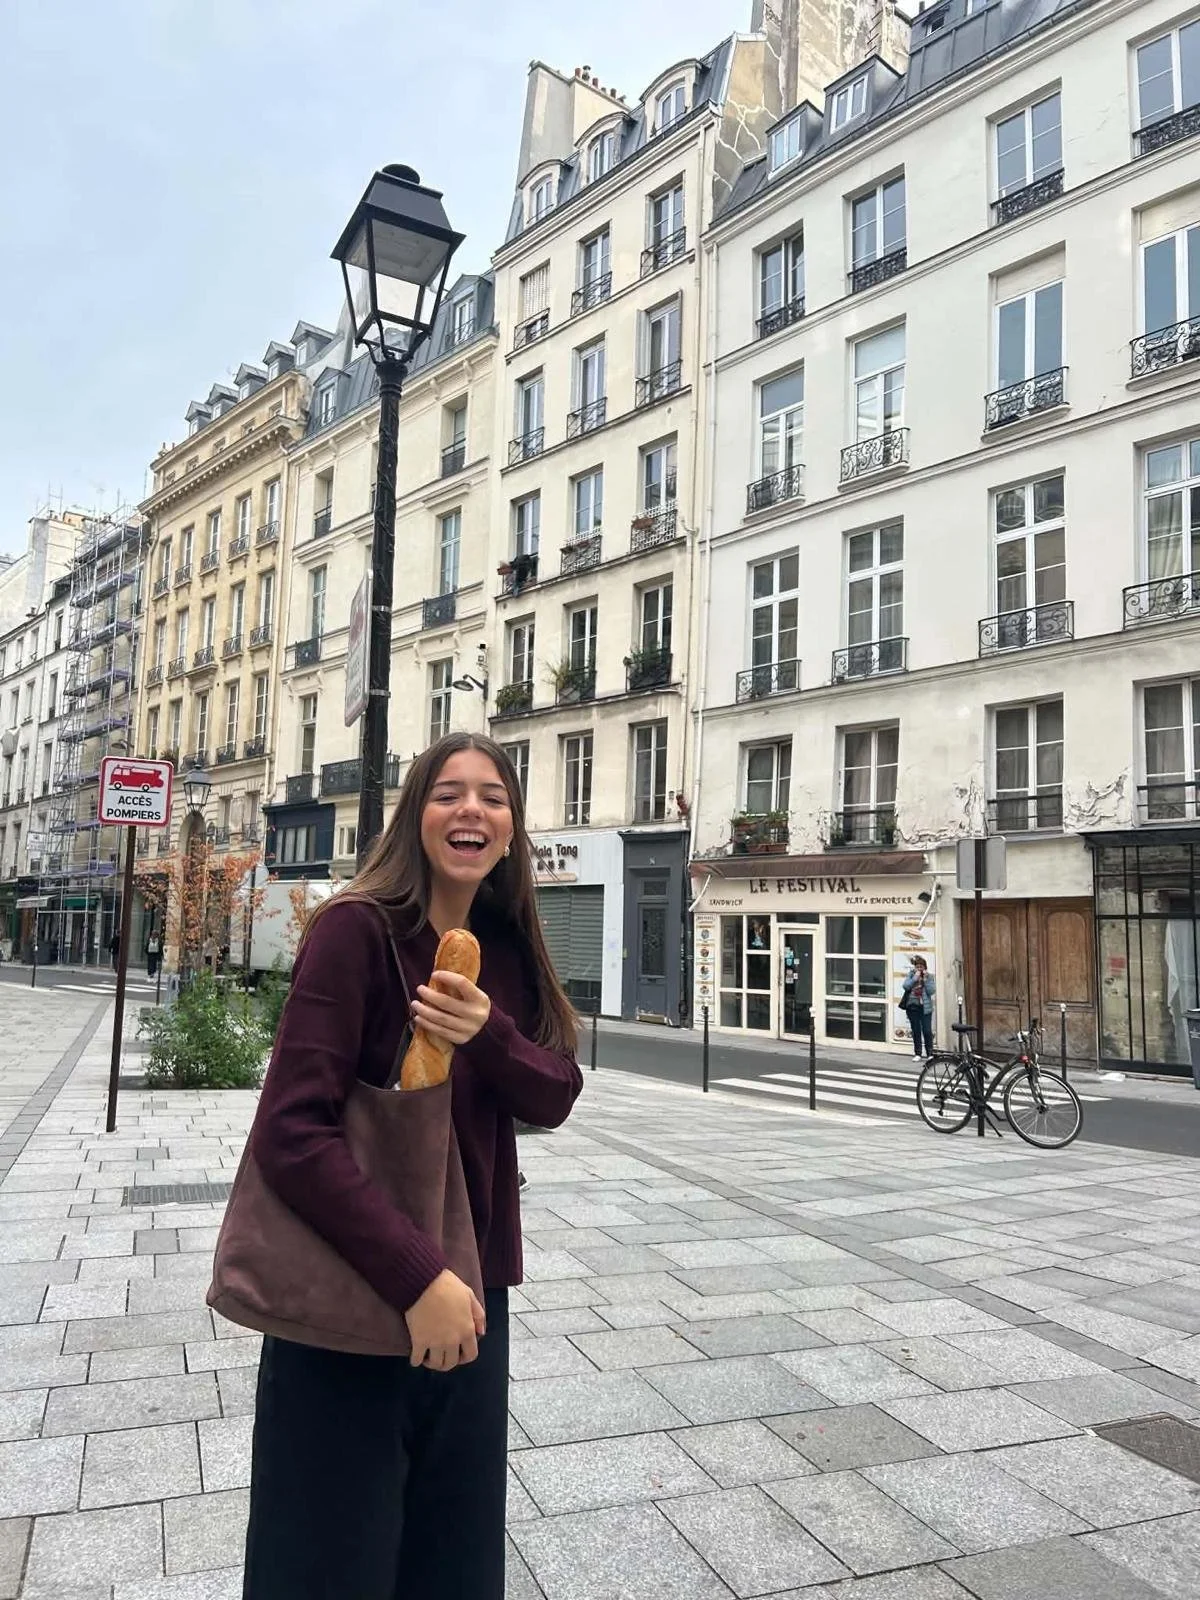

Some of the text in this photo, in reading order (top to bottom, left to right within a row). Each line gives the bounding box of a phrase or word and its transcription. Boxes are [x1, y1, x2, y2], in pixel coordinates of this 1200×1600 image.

[118, 795, 152, 806] ACCÈS
[107, 808, 161, 820] POMPIERS
[555, 843, 578, 859] Tang
[750, 877, 862, 894] LE FESTIVAL
